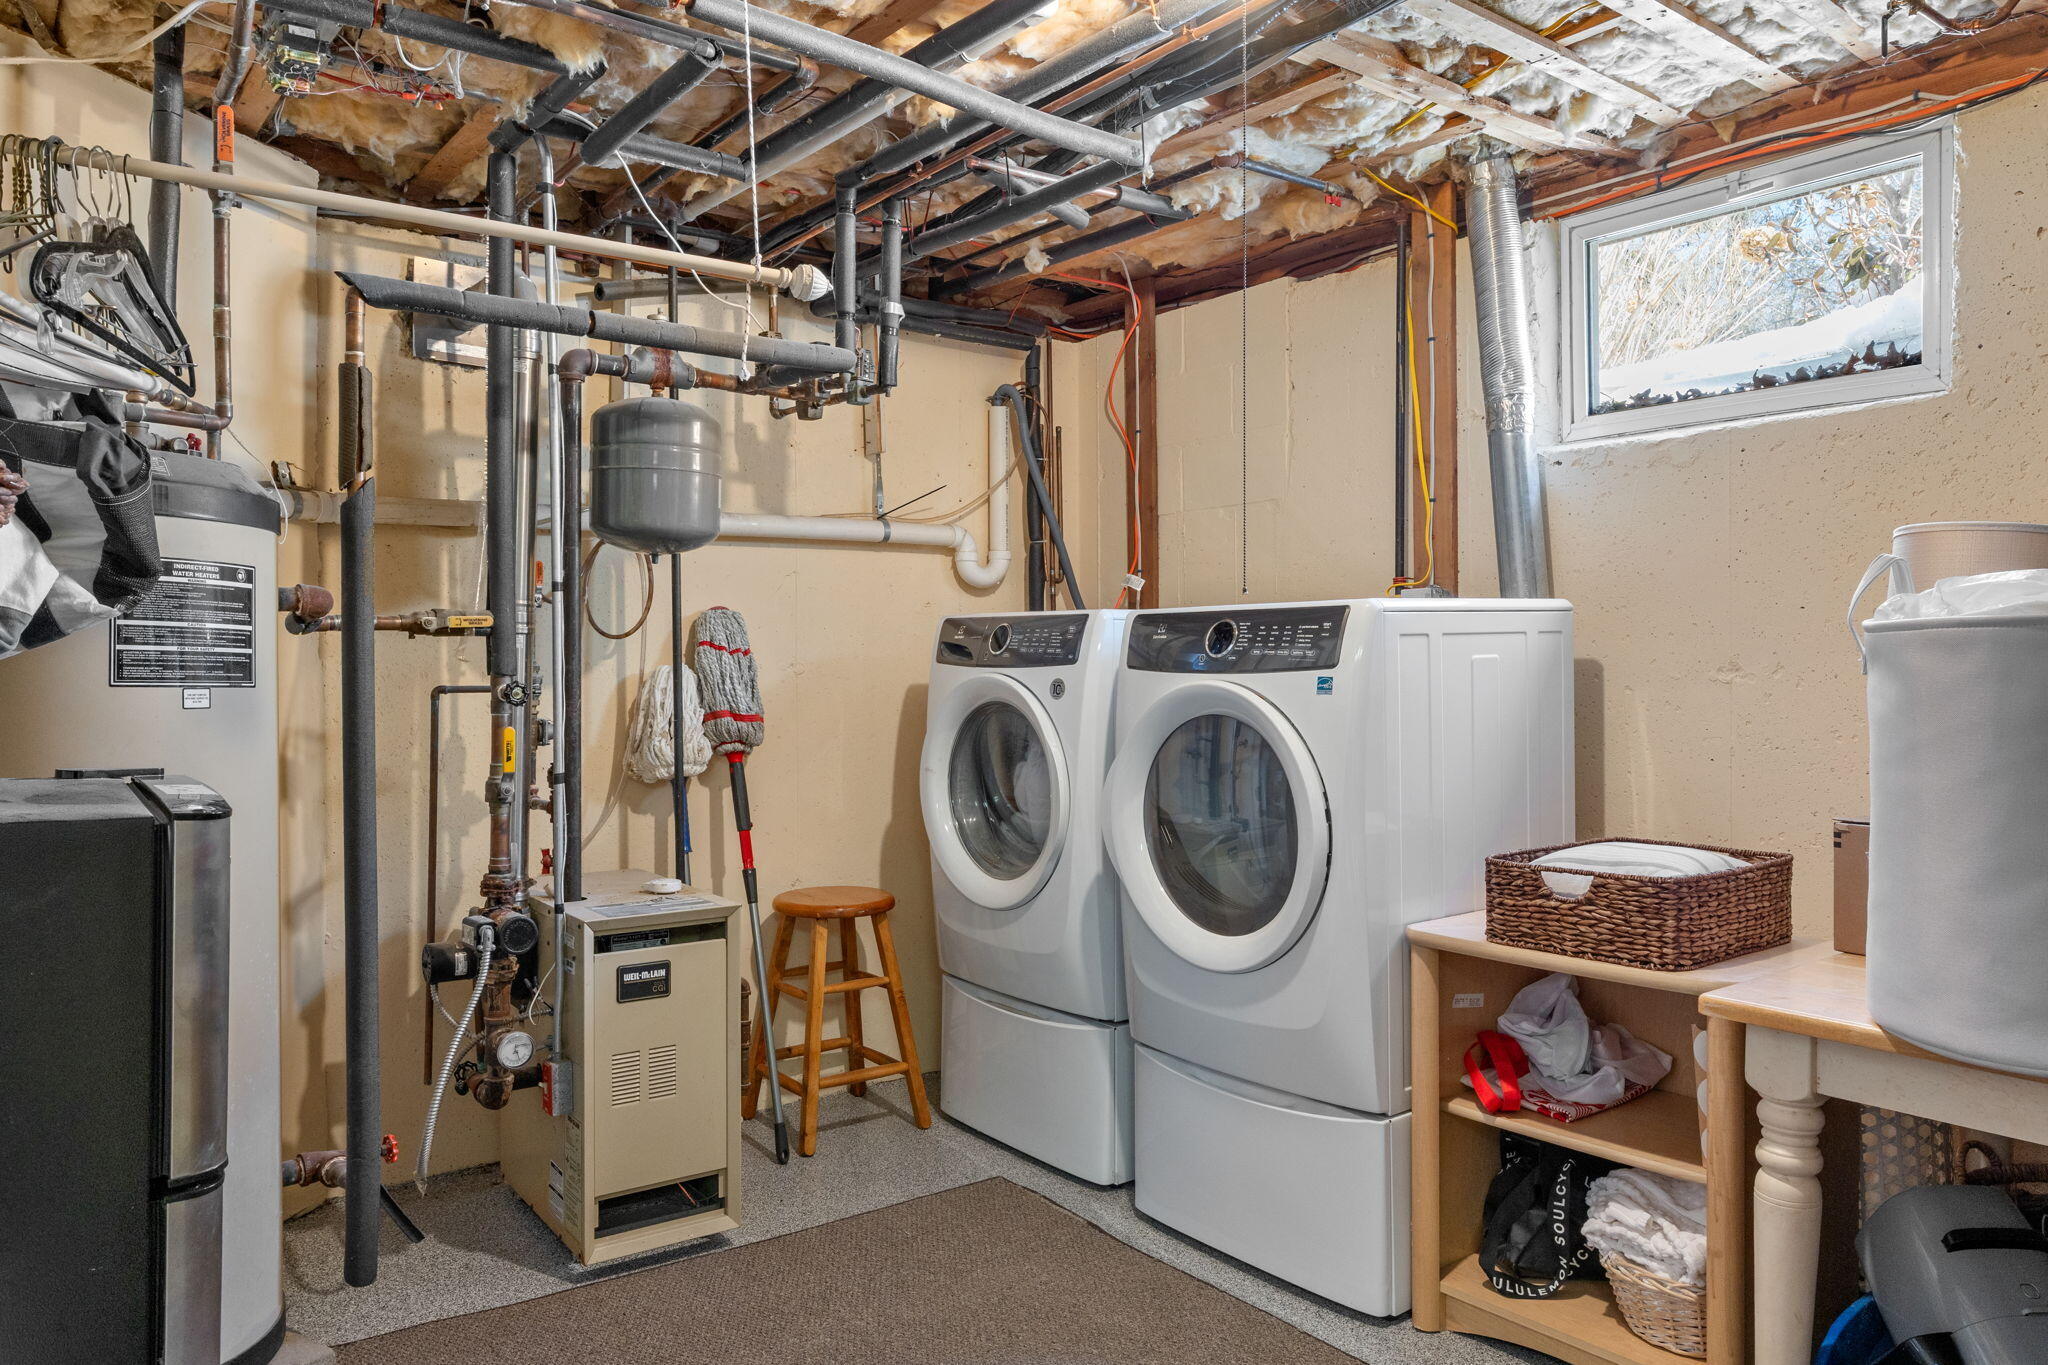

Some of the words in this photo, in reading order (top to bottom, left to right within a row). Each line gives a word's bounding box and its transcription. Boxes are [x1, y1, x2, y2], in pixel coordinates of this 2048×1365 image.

[173, 563, 219, 572] INDIRECT-FIRED
[195, 572, 220, 580] HEATERS
[1553, 1159, 1576, 1246] SOULCYC
[1492, 1255, 1568, 1297] ULULEMON
